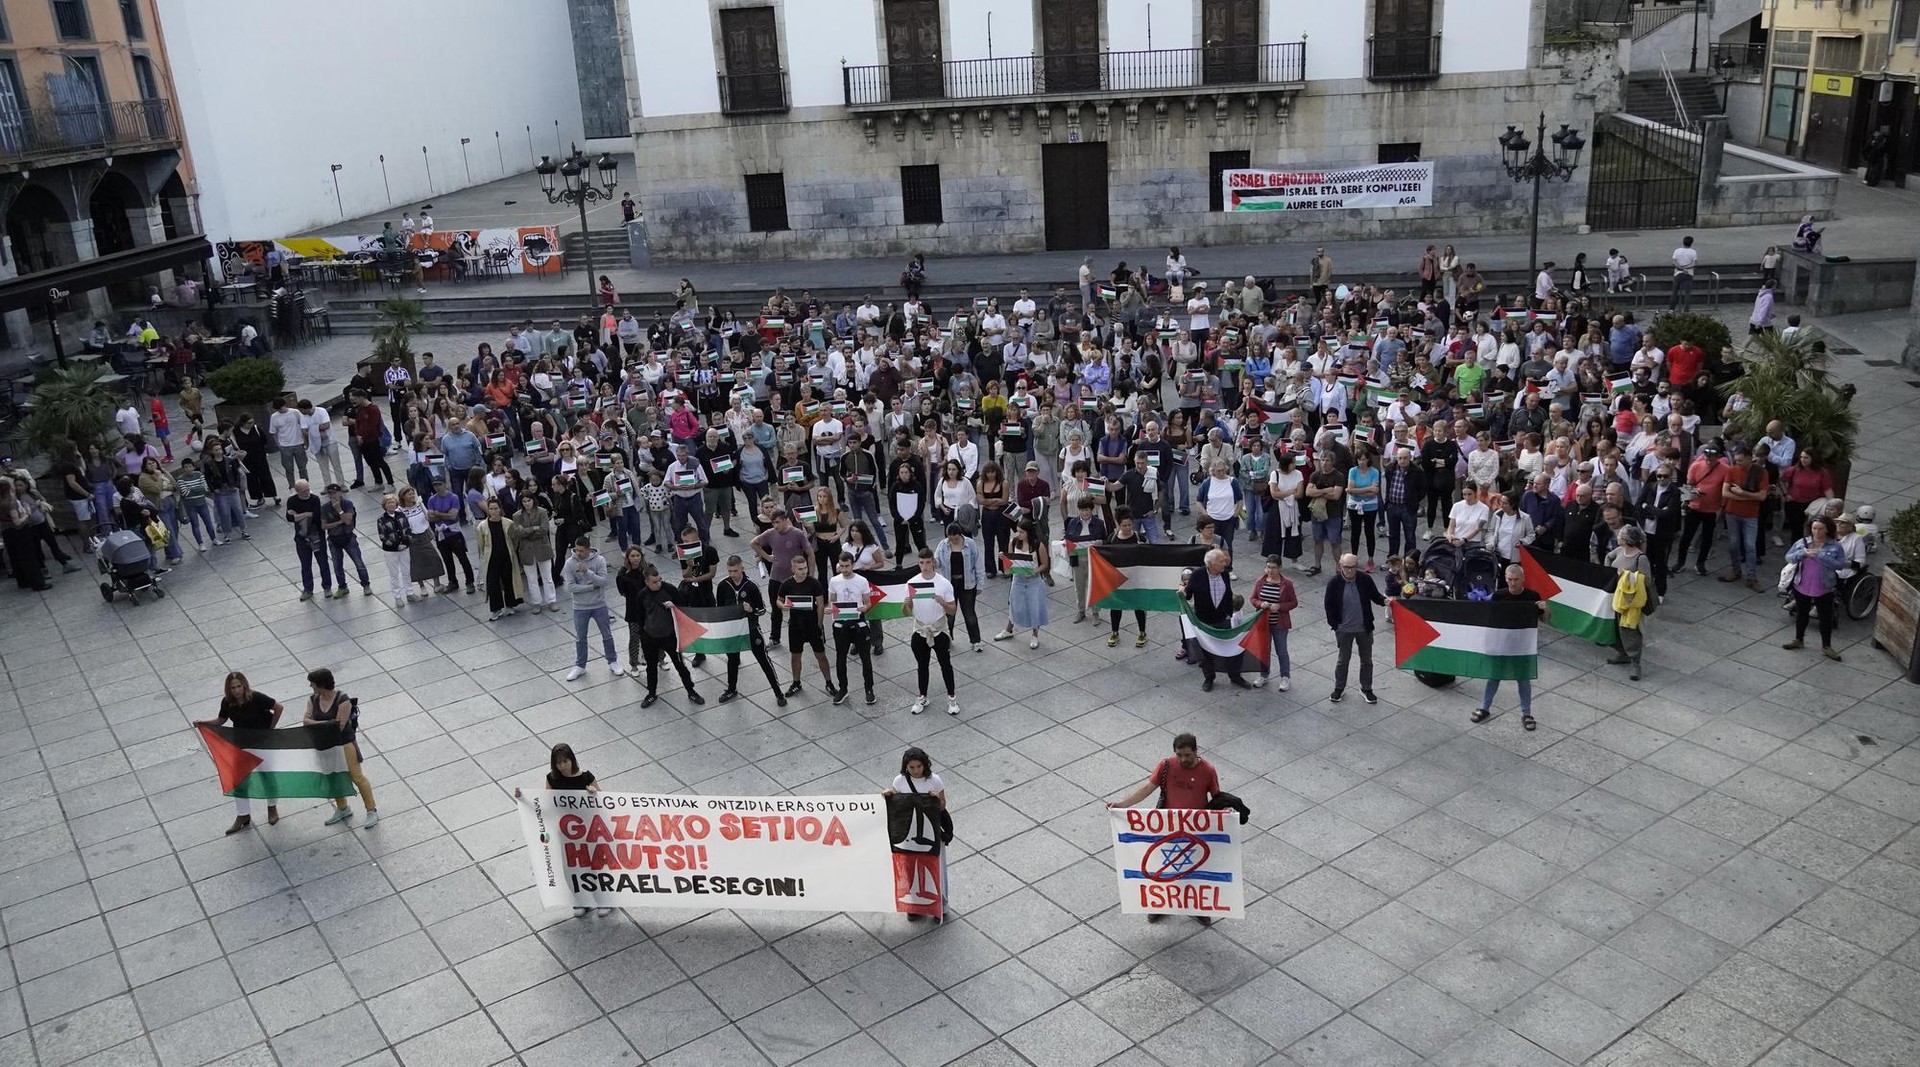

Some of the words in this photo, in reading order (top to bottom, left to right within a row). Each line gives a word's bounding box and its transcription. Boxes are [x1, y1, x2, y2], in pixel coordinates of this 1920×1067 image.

[1229, 173, 1266, 187] ISRAEL
[1285, 186, 1317, 196] ISRAEL
[1321, 185, 1339, 195] ETA
[1341, 185, 1363, 194] BERE
[1366, 183, 1421, 193] KONPLIZEEI
[1286, 201, 1318, 210] AURRE
[1321, 199, 1343, 208] EGIN
[1399, 196, 1416, 205] AGA
[553, 795, 626, 809] ISRAELGO
[632, 797, 699, 809] ESTATUAK
[708, 799, 774, 812] ONTZIDIA
[559, 813, 711, 842] GAZAKO
[719, 813, 851, 846] SETIOA
[1126, 809, 1231, 833] BOIKOT
[565, 843, 708, 871] HAUTSI!
[572, 873, 671, 893] ISRAEL
[674, 875, 805, 897] DESEGIN!
[1140, 884, 1230, 911] ISRAEL
